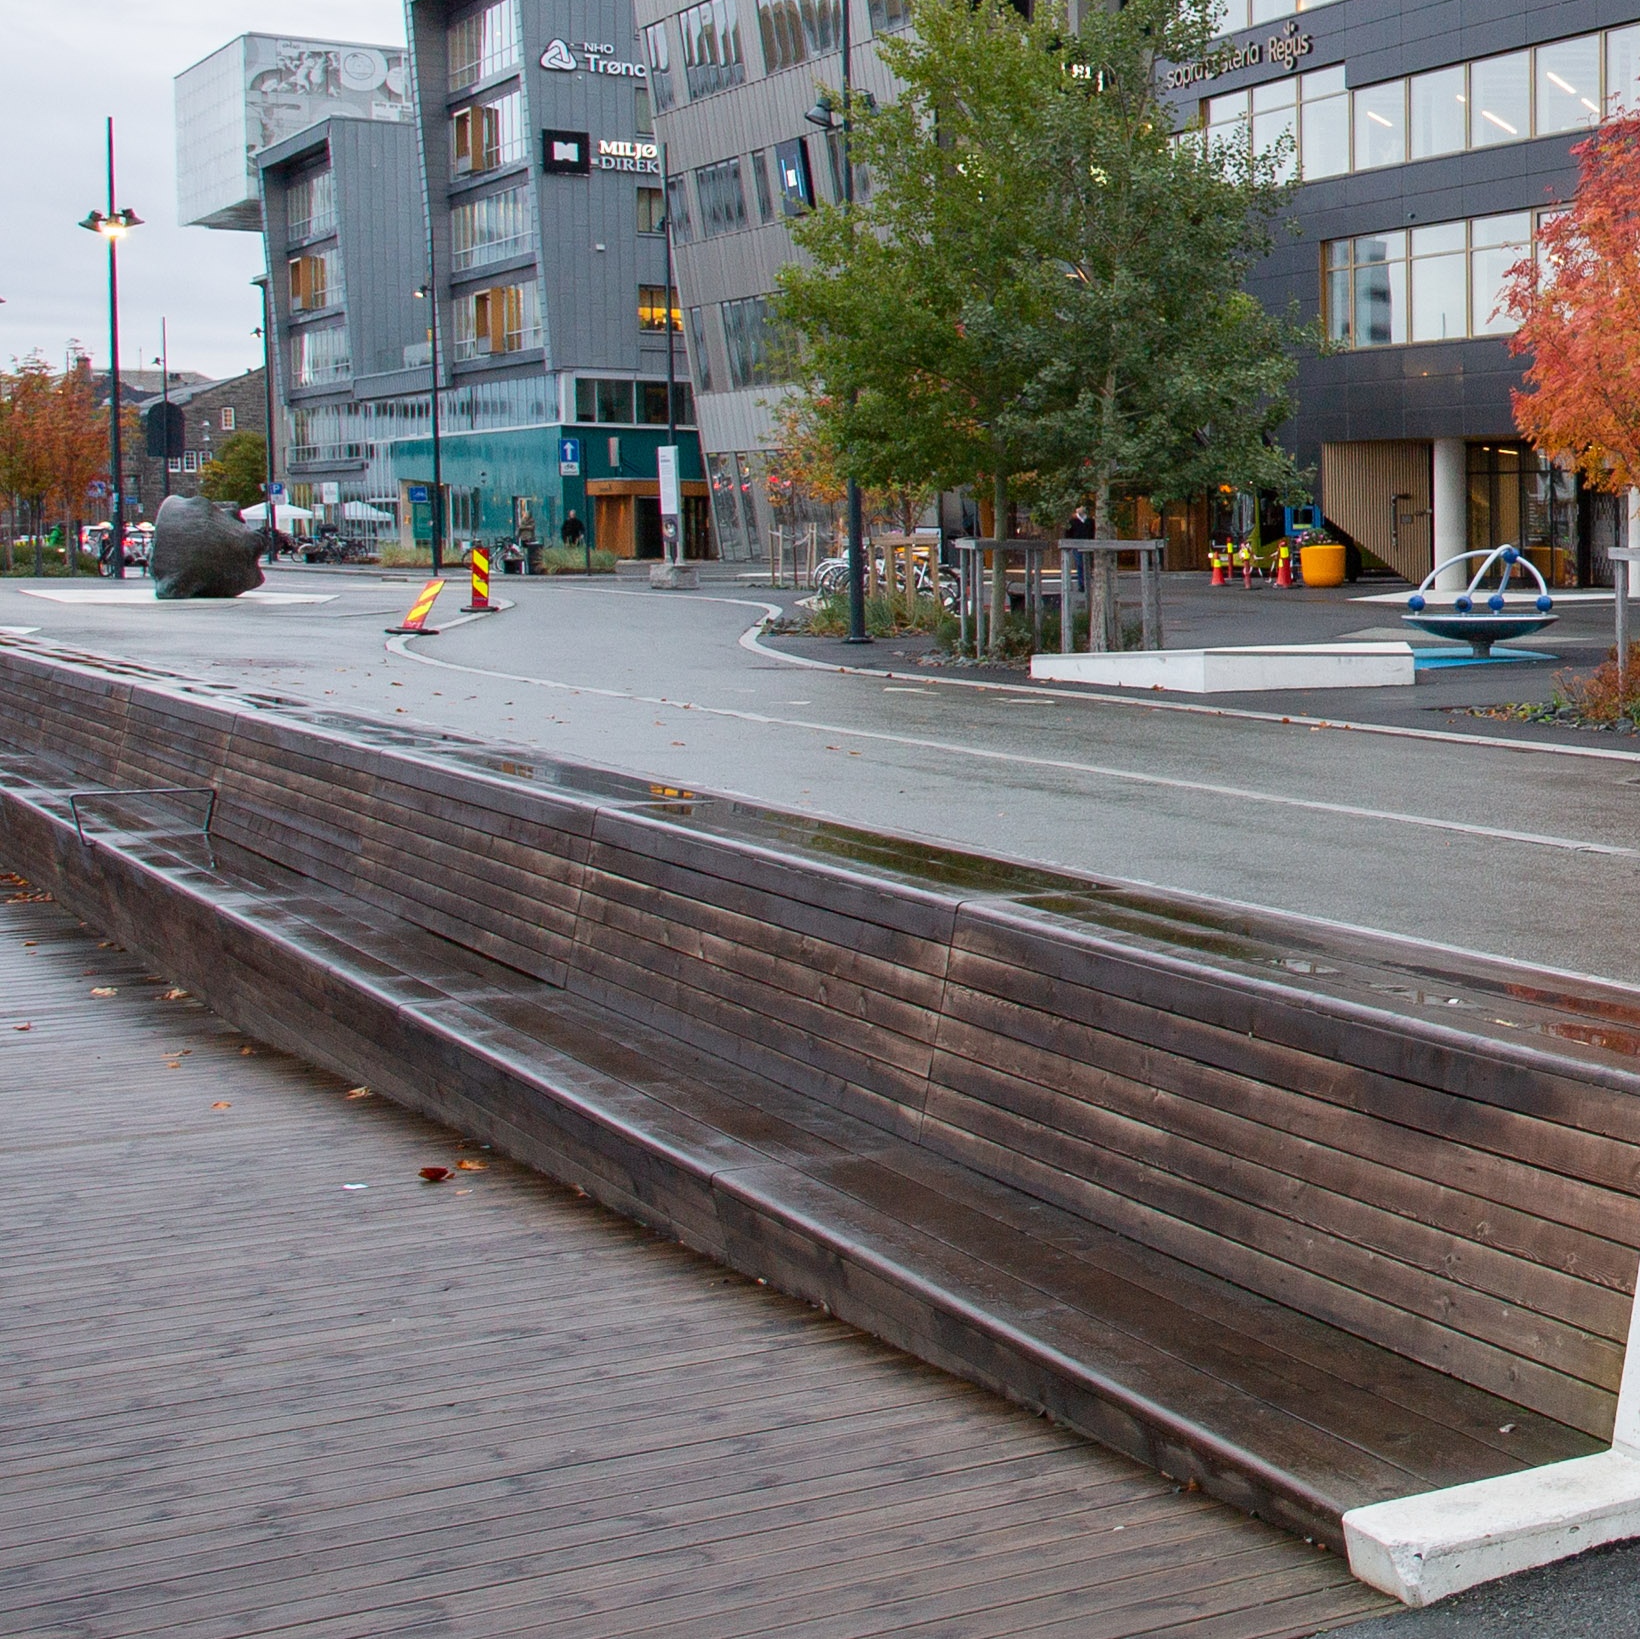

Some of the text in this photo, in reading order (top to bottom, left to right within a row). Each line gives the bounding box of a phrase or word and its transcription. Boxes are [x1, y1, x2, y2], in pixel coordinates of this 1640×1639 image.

[584, 42, 614, 54] NHO
[1268, 33, 1311, 70] Regus
[1167, 63, 1204, 89] sopra
[600, 140, 658, 159] MILJØ
[273, 484, 280, 493] P
